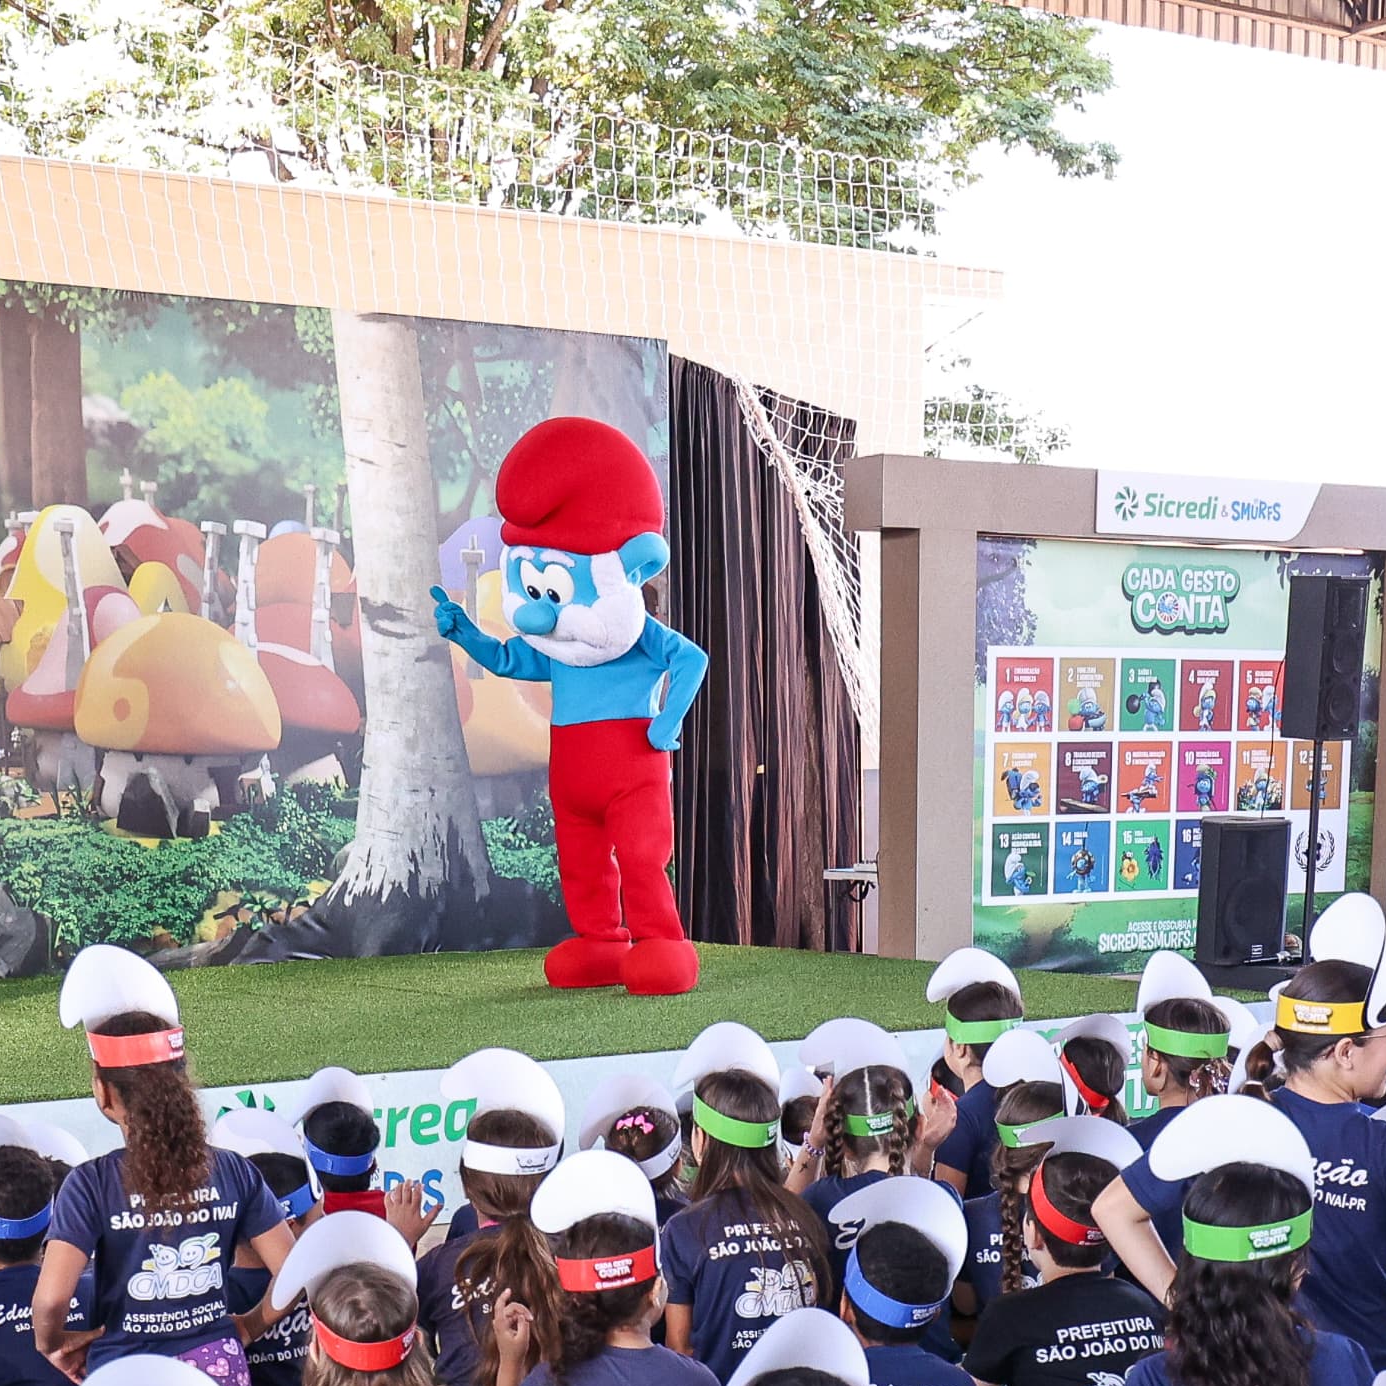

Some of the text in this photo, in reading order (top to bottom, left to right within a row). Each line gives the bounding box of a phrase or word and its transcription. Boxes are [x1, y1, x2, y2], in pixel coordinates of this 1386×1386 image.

[1144, 492, 1219, 520] Sicredi
[1127, 567, 1237, 593] CADA GESTO
[1135, 592, 1226, 625] CONTA
[1067, 667, 1074, 683] 2
[1128, 668, 1135, 683] 3
[1188, 669, 1195, 684] 4
[1246, 670, 1253, 684] 5
[1184, 751, 1195, 765] 10
[1127, 921, 1154, 932] ACESSE
[1158, 920, 1192, 931] DESCUBRA
[111, 1212, 145, 1230] SÃO
[213, 1201, 238, 1221] IVAÍ
[709, 1241, 740, 1260] SÃO
[976, 1249, 1001, 1263] SÃO
[124, 1300, 226, 1323] ASSISTÊNCIA SOCIAL
[144, 1322, 174, 1333] JOÃO
[175, 1320, 192, 1331] DO
[1056, 1316, 1155, 1344] PREFEITURA
[277, 1350, 292, 1361] DO
[1036, 1345, 1077, 1363] SÃO
[1080, 1338, 1127, 1358] JOÃO
[1129, 1335, 1150, 1350] DO
